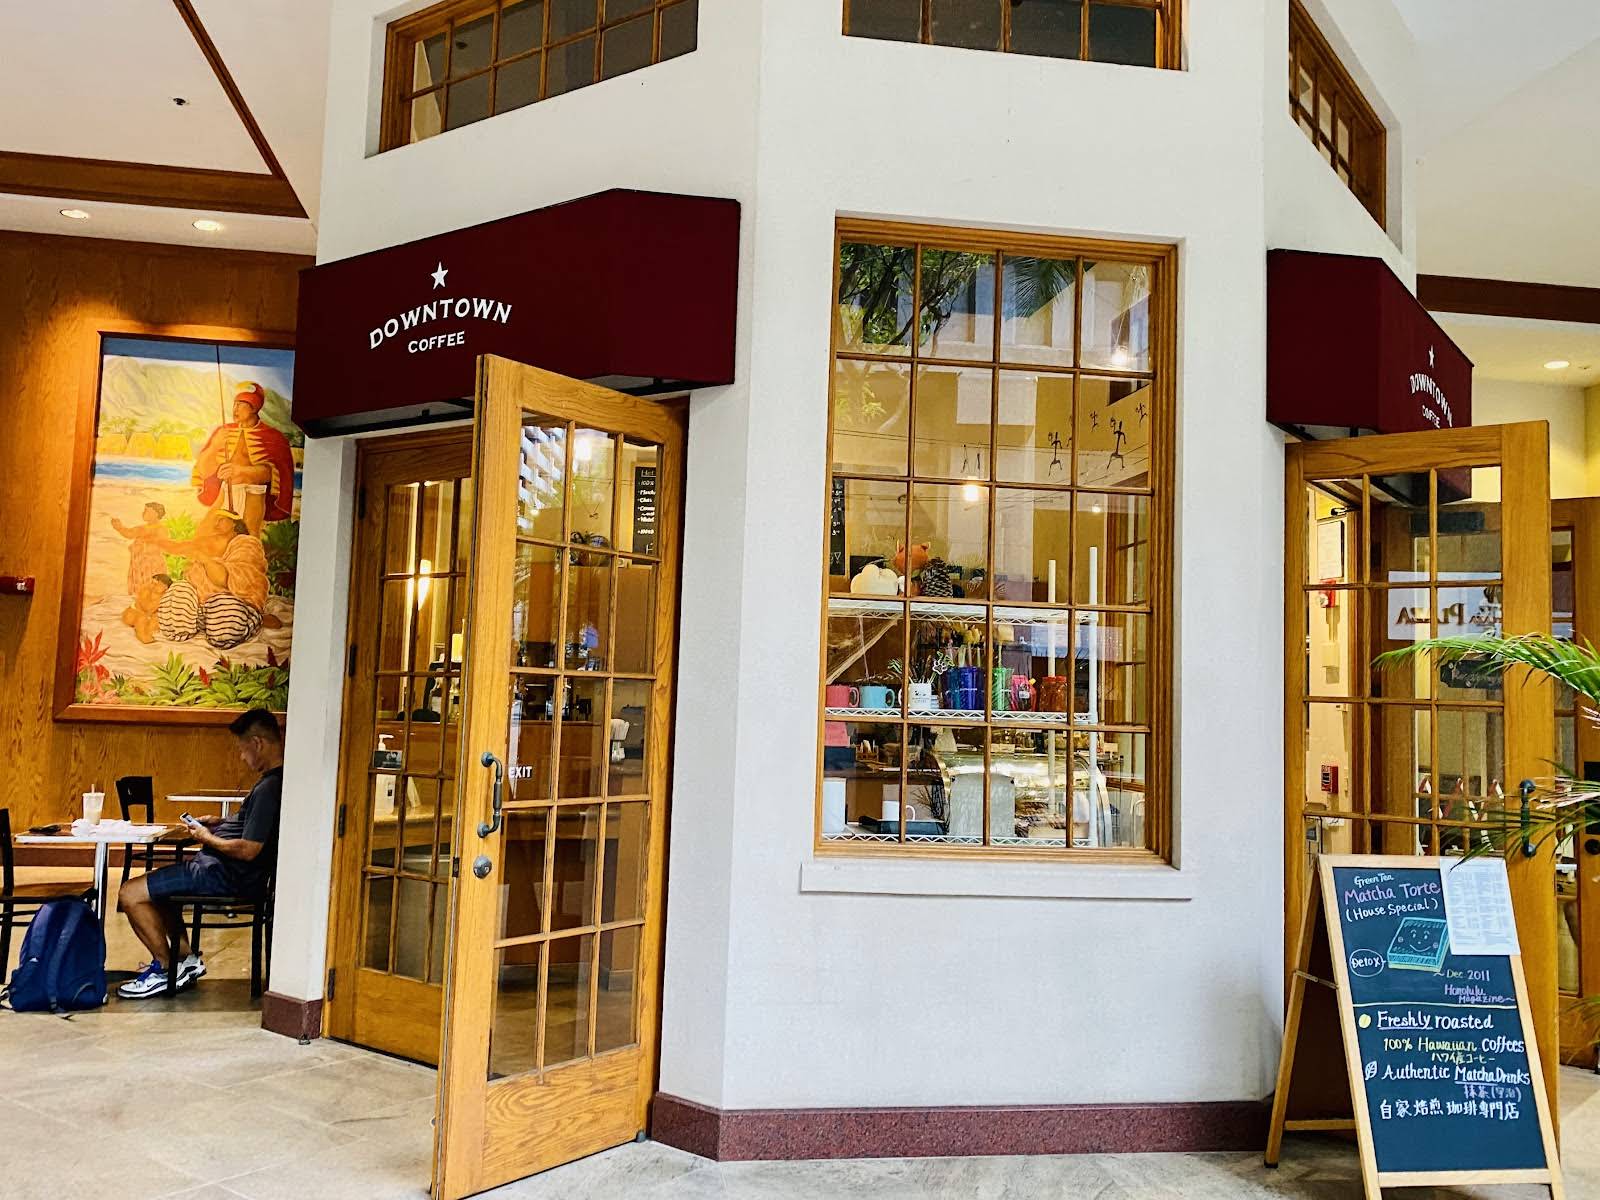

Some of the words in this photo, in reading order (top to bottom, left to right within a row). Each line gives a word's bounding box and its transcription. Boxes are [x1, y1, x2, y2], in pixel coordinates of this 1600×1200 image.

[369, 297, 513, 350] DOWNTOWN
[408, 330, 465, 354] COFFEE
[1409, 373, 1453, 428] DOWNTOWN
[509, 765, 533, 779] EXIT
[1354, 873, 1379, 889] Green
[1344, 884, 1396, 905] Matcha
[1398, 882, 1441, 899] Torte
[1345, 906, 1386, 922] (House
[1351, 956, 1381, 969] Detox
[1467, 969, 1490, 981] 2011
[1444, 983, 1487, 996] Honolulu
[1377, 1010, 1432, 1029] Freshly
[1435, 1013, 1494, 1029] roasted
[1384, 1037, 1413, 1052] 100%
[1381, 1062, 1451, 1080] Authentic
